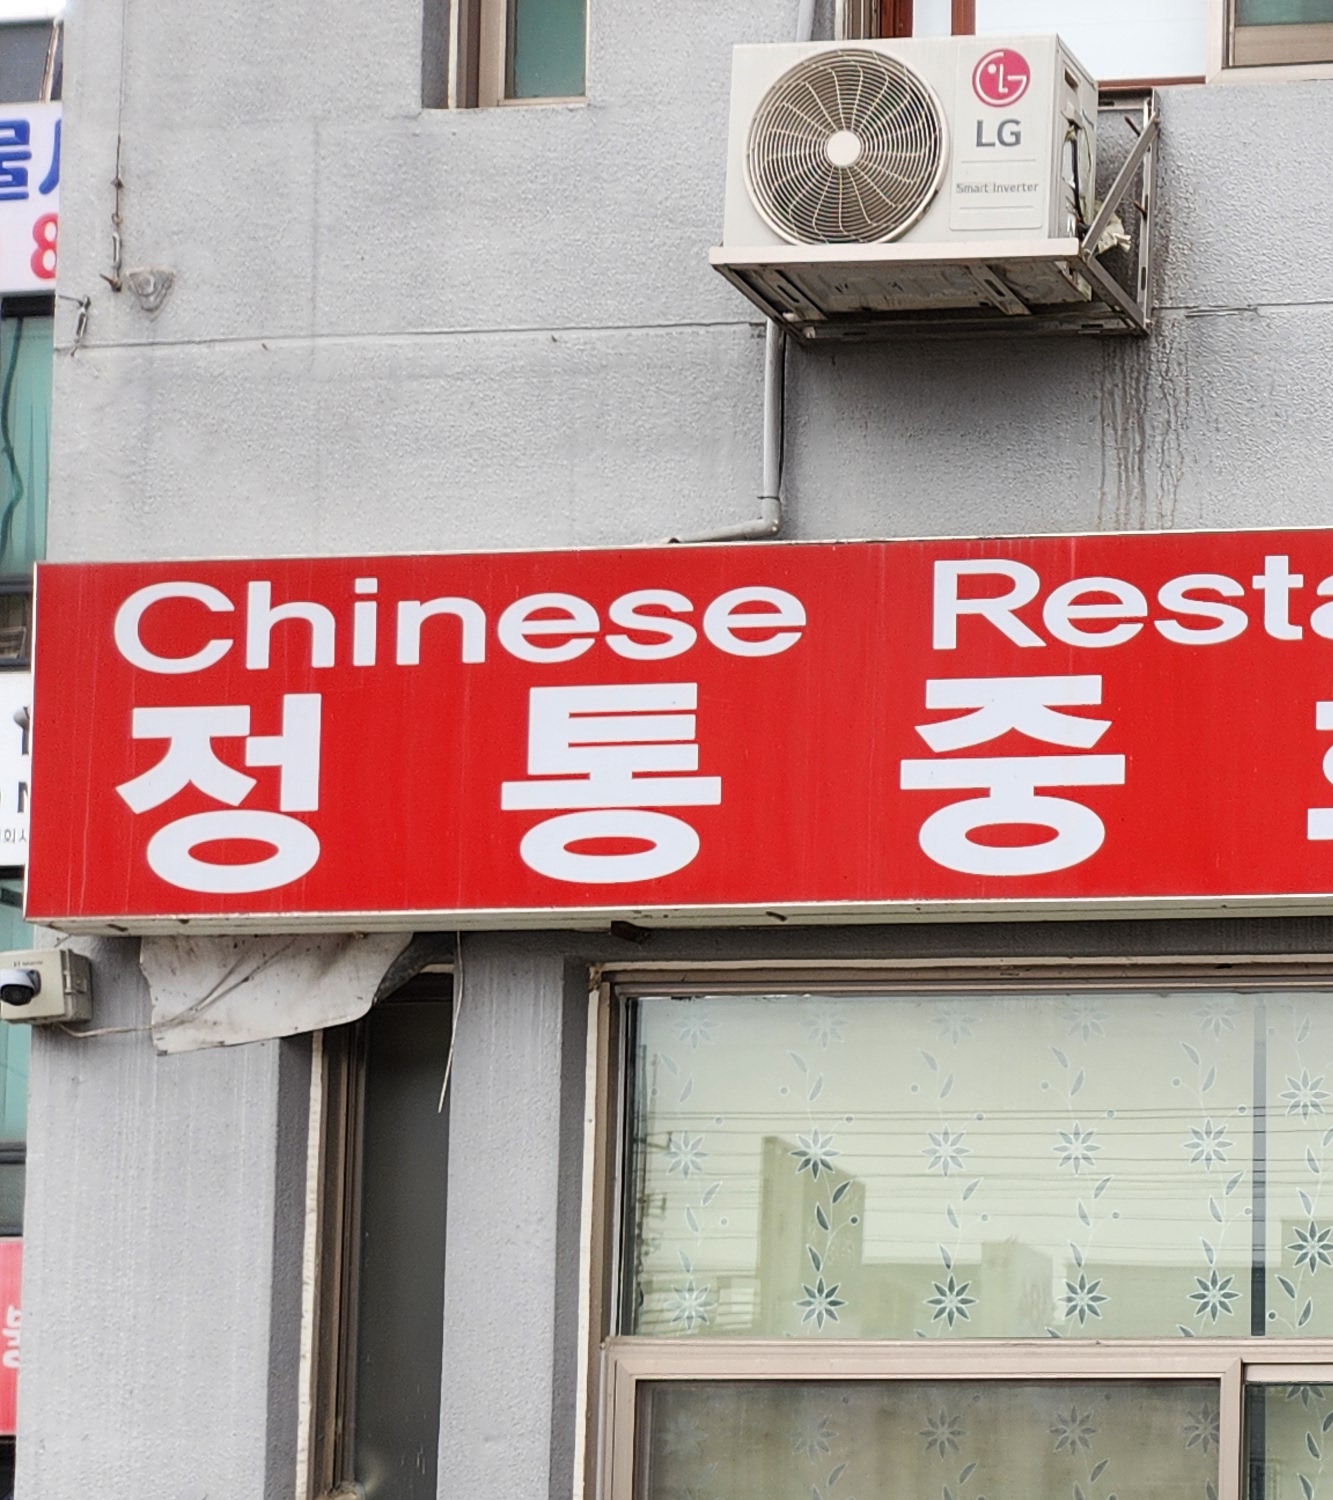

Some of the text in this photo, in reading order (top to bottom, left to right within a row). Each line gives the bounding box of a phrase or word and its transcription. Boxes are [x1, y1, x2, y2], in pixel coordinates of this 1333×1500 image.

[975, 118, 1021, 147] LG
[956, 181, 1039, 194] Smart Inverter
[113, 577, 807, 676] Chinese
